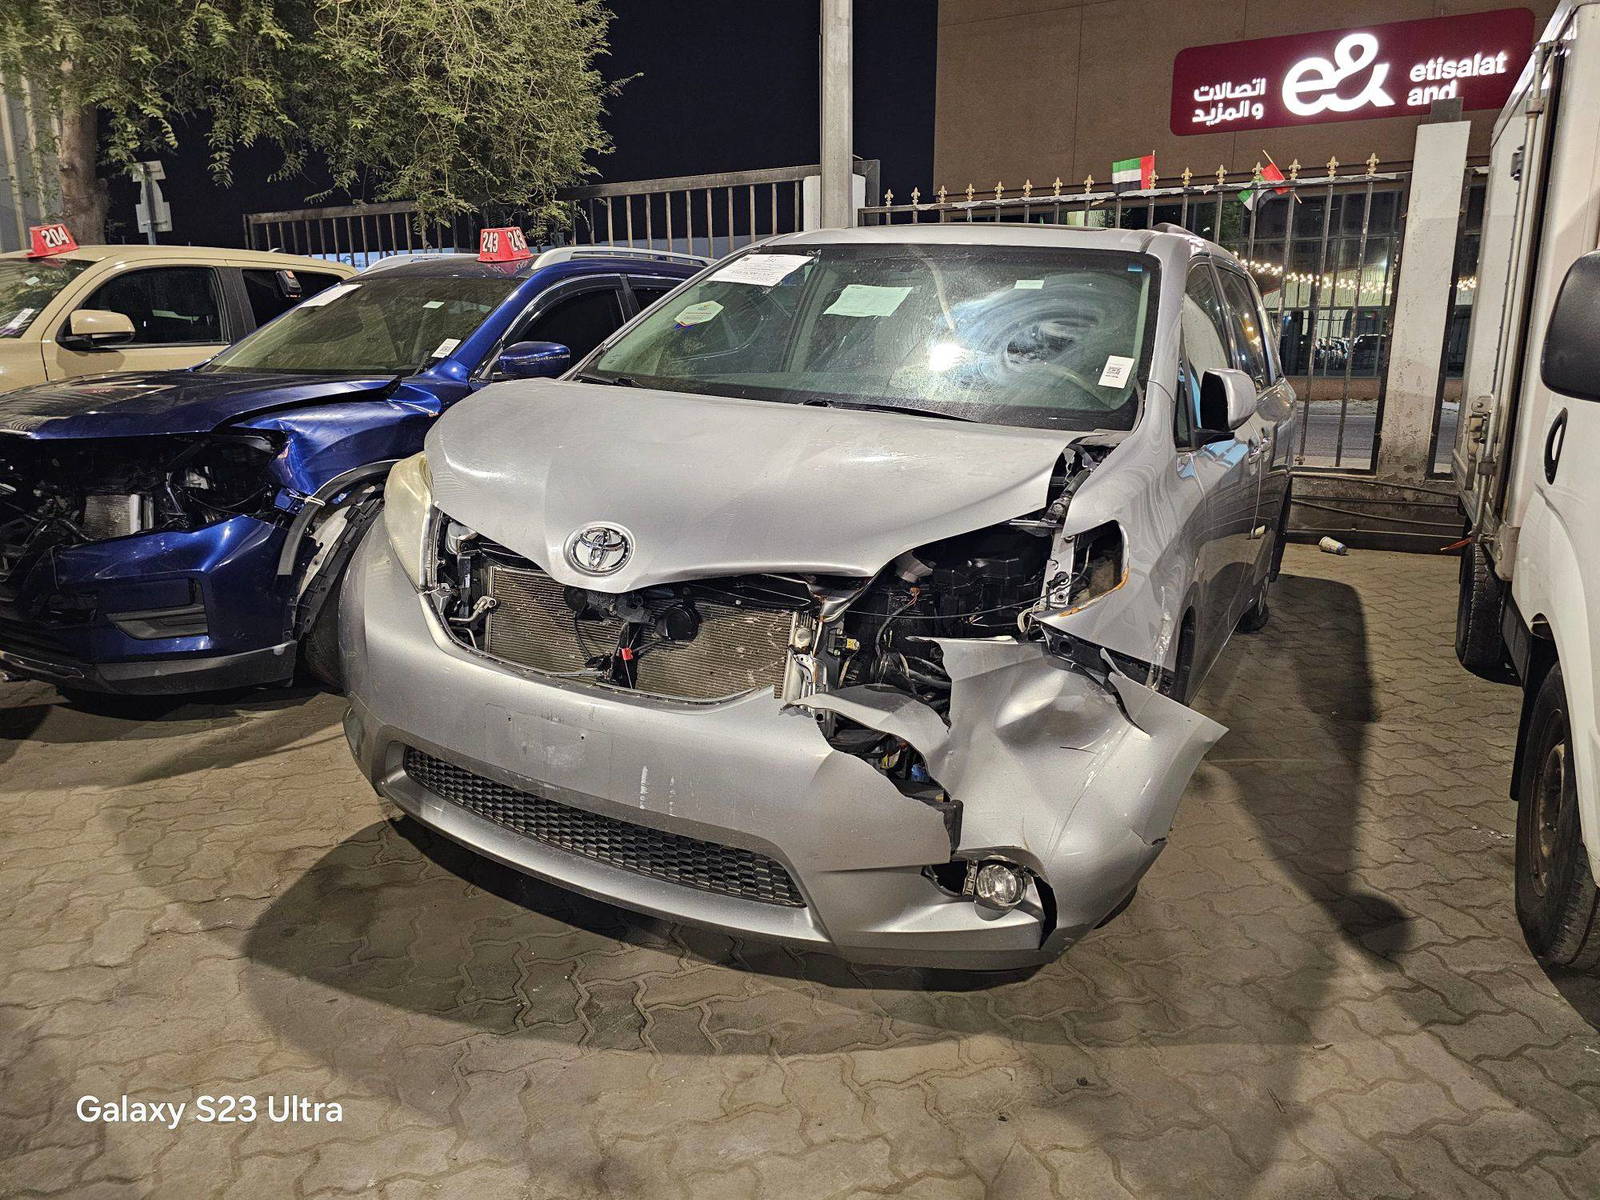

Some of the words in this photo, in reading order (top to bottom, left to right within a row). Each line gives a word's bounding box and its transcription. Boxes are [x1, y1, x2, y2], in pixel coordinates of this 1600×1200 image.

[1281, 33, 1396, 116] e&
[1409, 51, 1508, 82] etisalat
[1193, 77, 1267, 102] اتصالات
[1406, 79, 1458, 106] and
[1192, 100, 1264, 126] والمزيد
[41, 226, 70, 248] 204
[482, 231, 499, 253] 243
